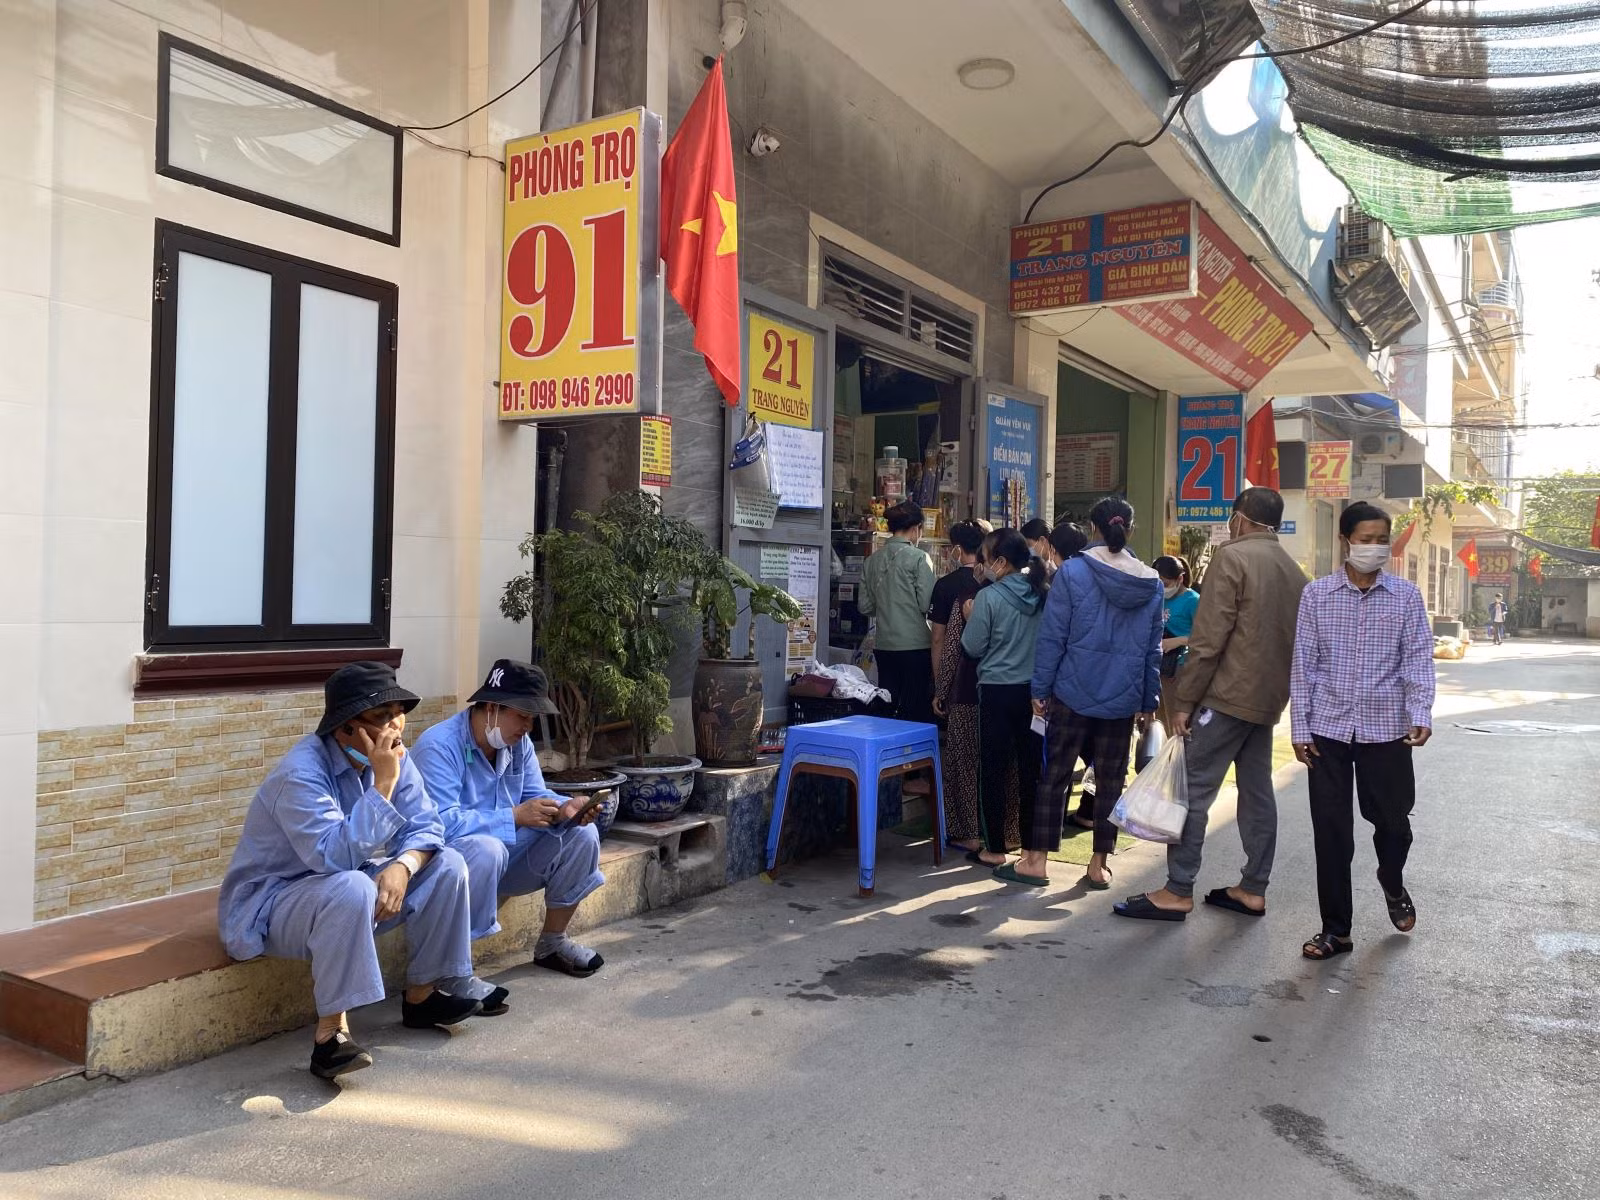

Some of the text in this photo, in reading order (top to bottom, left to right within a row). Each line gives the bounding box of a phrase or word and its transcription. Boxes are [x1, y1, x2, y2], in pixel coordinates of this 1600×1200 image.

[509, 126, 635, 201] PHÒNG TRỌ
[1017, 239, 1182, 277] TRANG NGUYÊN
[1027, 234, 1073, 257] 21
[507, 209, 634, 359] 91
[1131, 262, 1159, 278] BÌNH
[1014, 283, 1082, 300] 0933 432 007
[1014, 300, 1038, 310] 0972
[1200, 276, 1268, 343] PHÒNG
[1242, 313, 1288, 364] TRỌ
[1263, 331, 1300, 366] 21
[762, 329, 802, 390] 21
[503, 373, 634, 412] ĐT: 098 946 2990
[752, 388, 778, 410] TRANG
[1008, 447, 1020, 464] BÁN
[1180, 436, 1238, 500] 21
[1311, 454, 1348, 479] 27
[1190, 506, 1208, 517] 0972
[1481, 556, 1509, 573] 39
